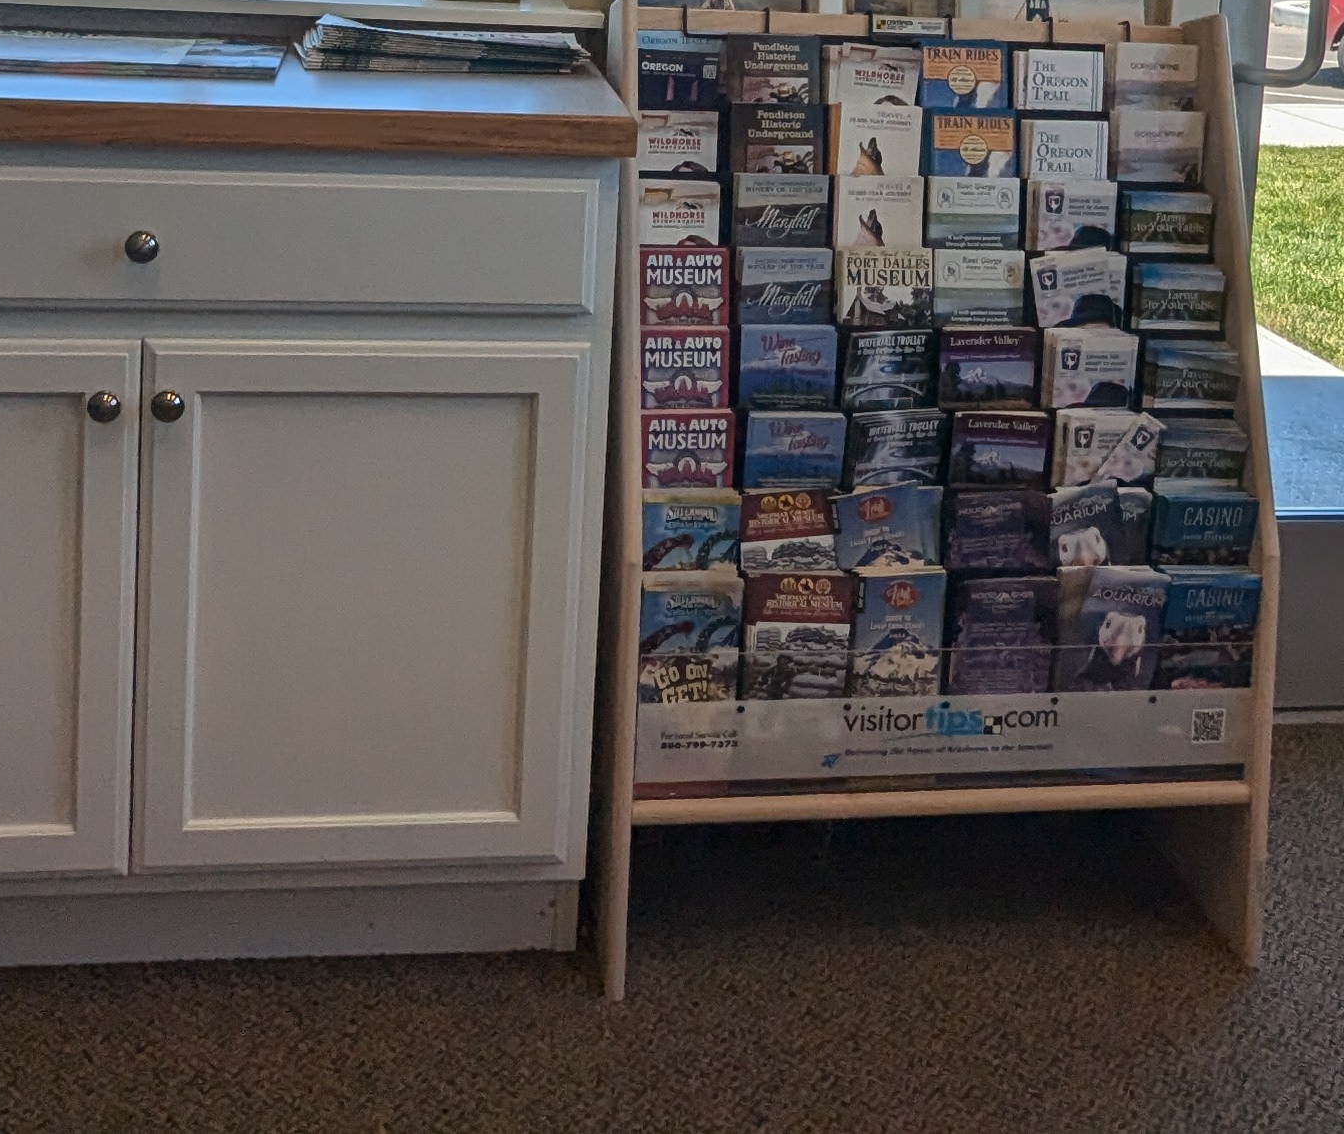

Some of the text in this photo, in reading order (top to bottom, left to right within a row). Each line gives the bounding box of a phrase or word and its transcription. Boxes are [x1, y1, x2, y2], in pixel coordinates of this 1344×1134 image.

[752, 41, 801, 52] Pendleton
[756, 51, 797, 61] Historic
[926, 47, 1000, 61] TRAIN RIDES
[641, 61, 684, 72] OREGON
[743, 60, 809, 72] Underground
[1032, 60, 1056, 72] THE
[1032, 72, 1089, 88] OREGON
[1032, 86, 1072, 102] TRAIL
[756, 109, 806, 120] Pendleton
[760, 119, 802, 129] Historic
[937, 117, 1012, 131] TRAIN RIDES
[747, 128, 814, 140] Underground
[1036, 131, 1060, 143] THE
[648, 136, 702, 147] WILDHORSE
[1036, 143, 1094, 159] OREGON
[1035, 157, 1074, 173] TRAIL
[651, 211, 706, 221] WILDHORSE
[745, 204, 821, 239] Maryhill
[646, 254, 723, 268] AIR & AUTO
[846, 257, 931, 270] FORT DALLES
[645, 268, 723, 286] MUSEUM
[846, 268, 931, 287] MUSEUM
[747, 282, 822, 316] Maryhill
[644, 336, 722, 350] AIR & AUTO
[761, 332, 796, 352] Wine
[858, 334, 927, 349] WATERFALL TROLLEY
[949, 335, 1020, 347] Lavender Valley
[644, 350, 722, 368] MUSEUM
[780, 347, 822, 366] Tasting
[648, 419, 728, 432] AIR & AUTO
[908, 420, 940, 432] TROLLEY
[968, 419, 1039, 434] Lavender Valley
[648, 432, 727, 451] MUSEUM
[1183, 506, 1244, 528] CASINO
[1091, 588, 1165, 609] AQUARIUM
[1186, 588, 1245, 610] CASINO
[655, 666, 680, 690] GO
[662, 680, 708, 705] GET!
